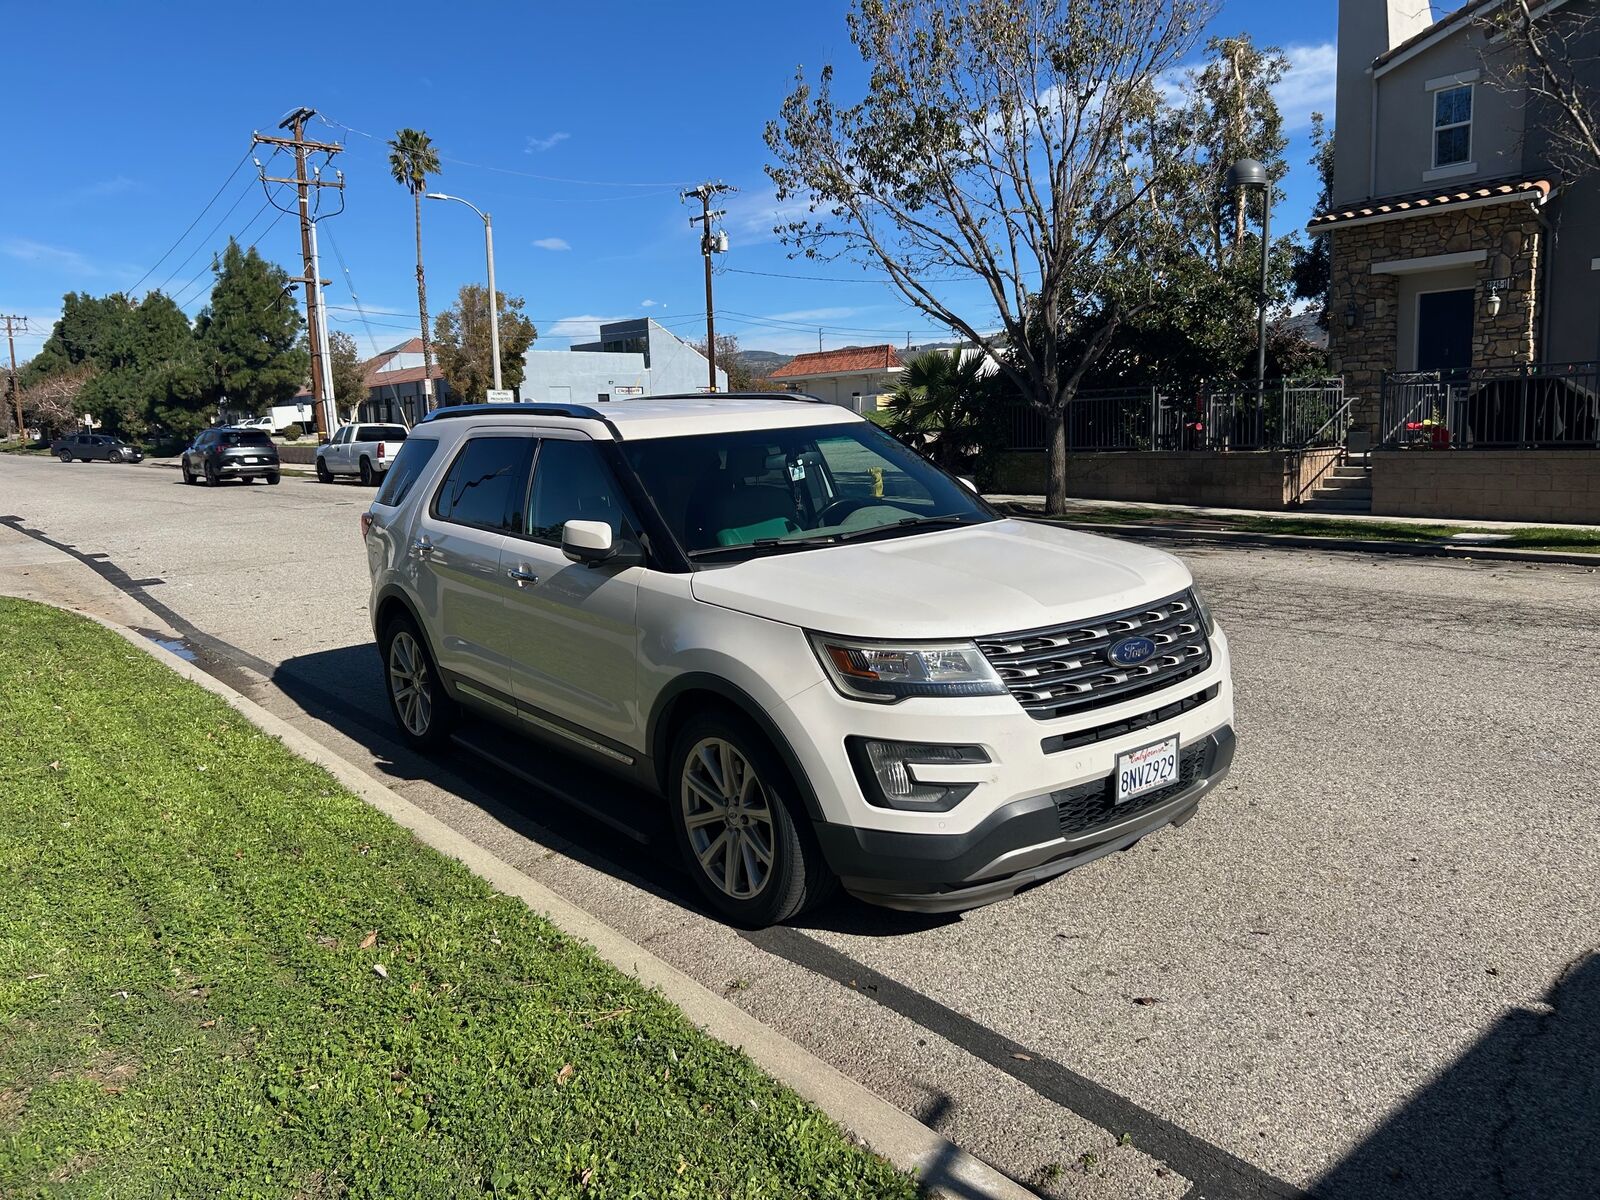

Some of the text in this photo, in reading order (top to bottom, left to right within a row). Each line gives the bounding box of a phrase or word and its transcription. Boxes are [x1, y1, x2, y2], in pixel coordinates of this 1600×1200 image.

[1124, 642, 1150, 660] Ford
[1130, 746, 1166, 764] California
[1121, 754, 1175, 793] 8NVZ929
